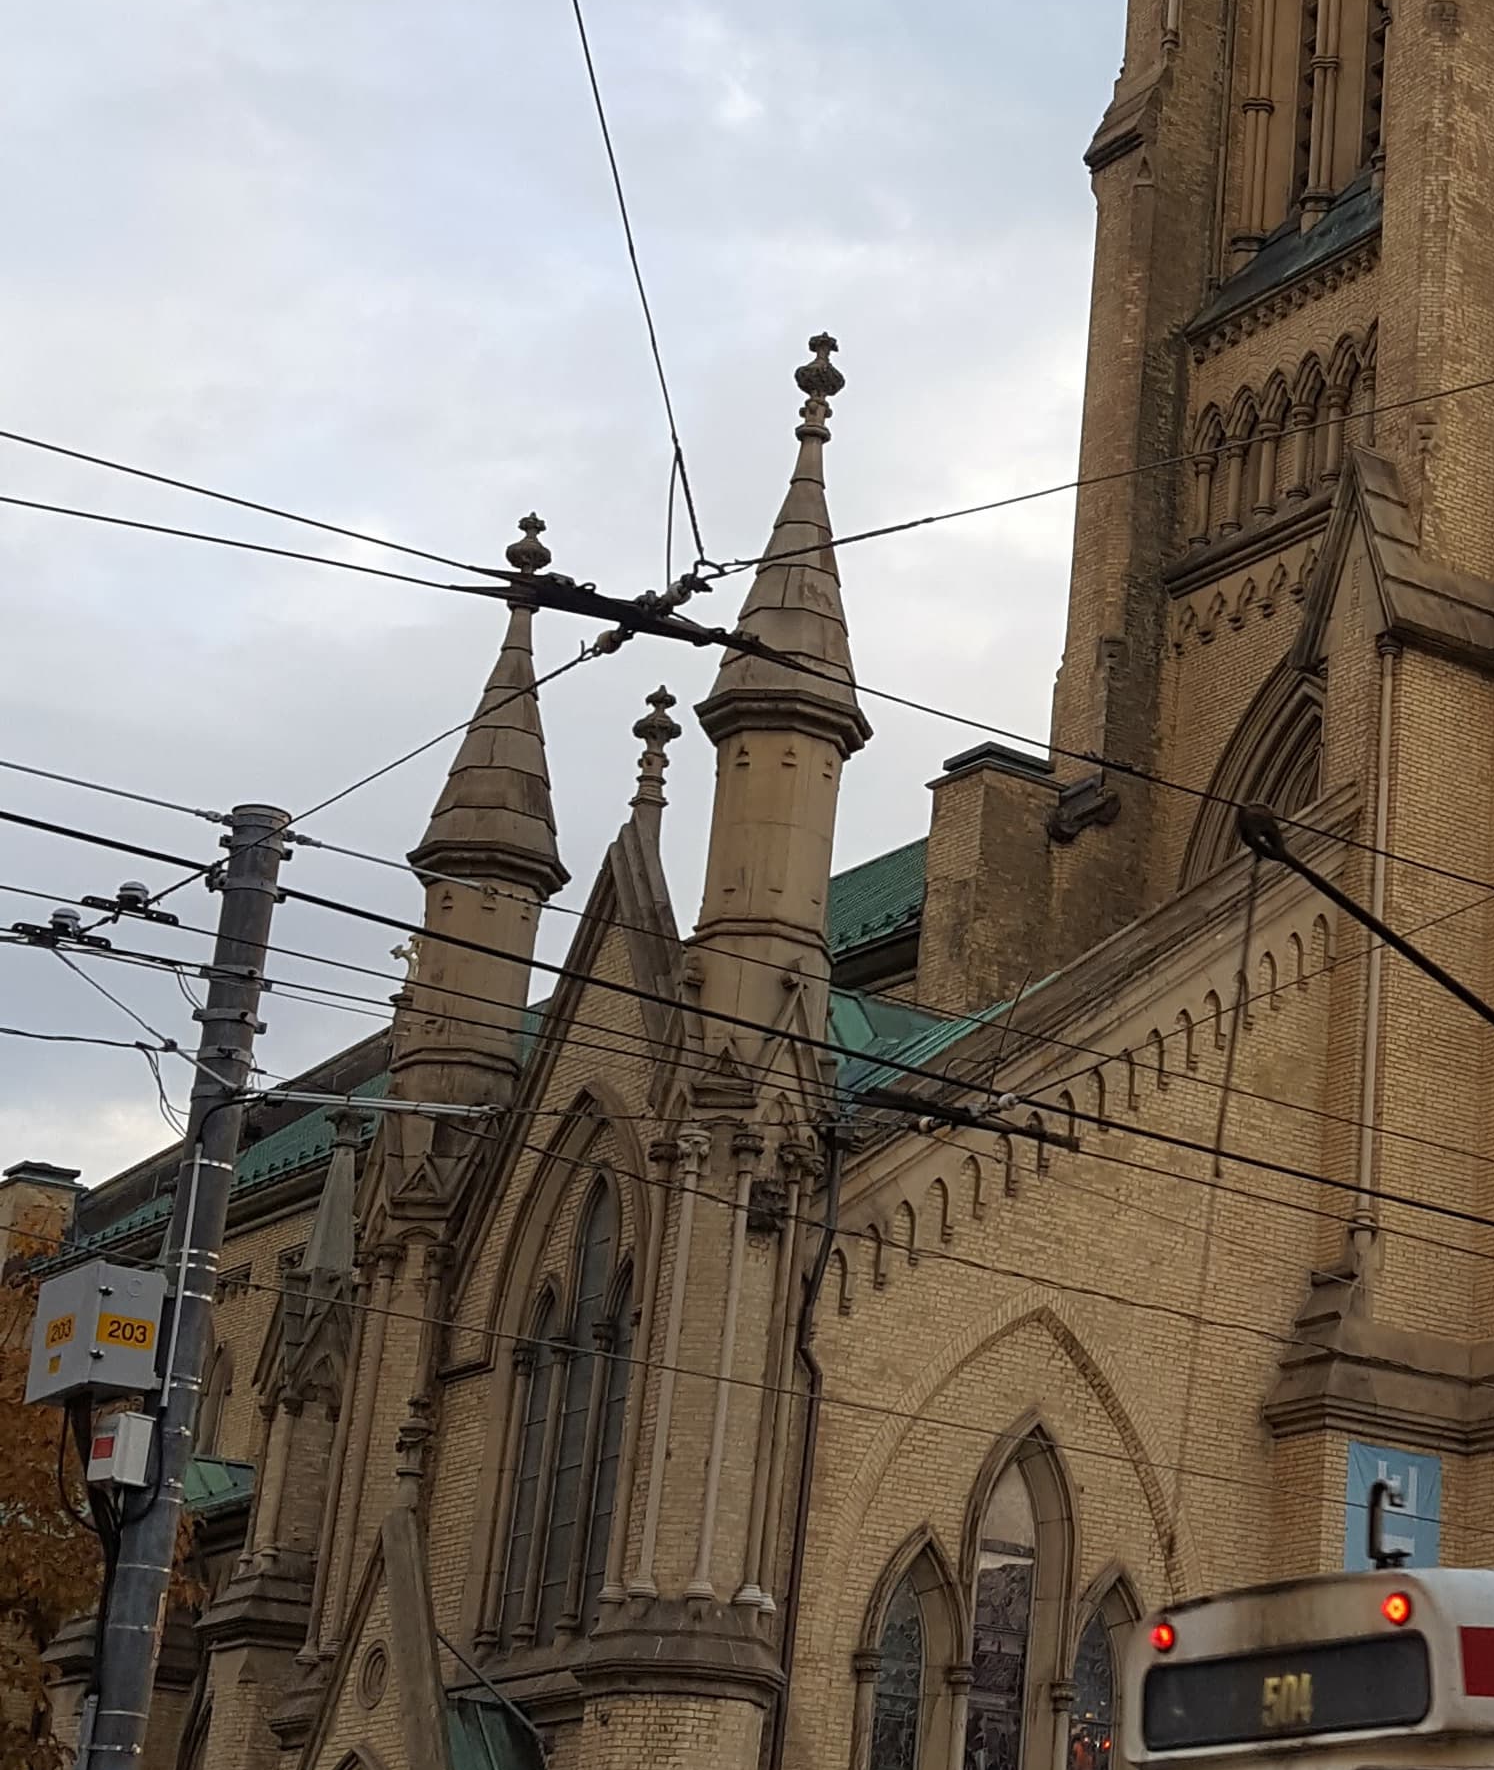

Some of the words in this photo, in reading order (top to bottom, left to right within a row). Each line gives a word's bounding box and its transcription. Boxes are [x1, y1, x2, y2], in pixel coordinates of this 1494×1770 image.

[50, 1318, 72, 1343] 203
[108, 1319, 148, 1344] 203
[1262, 1672, 1313, 1727] 504
